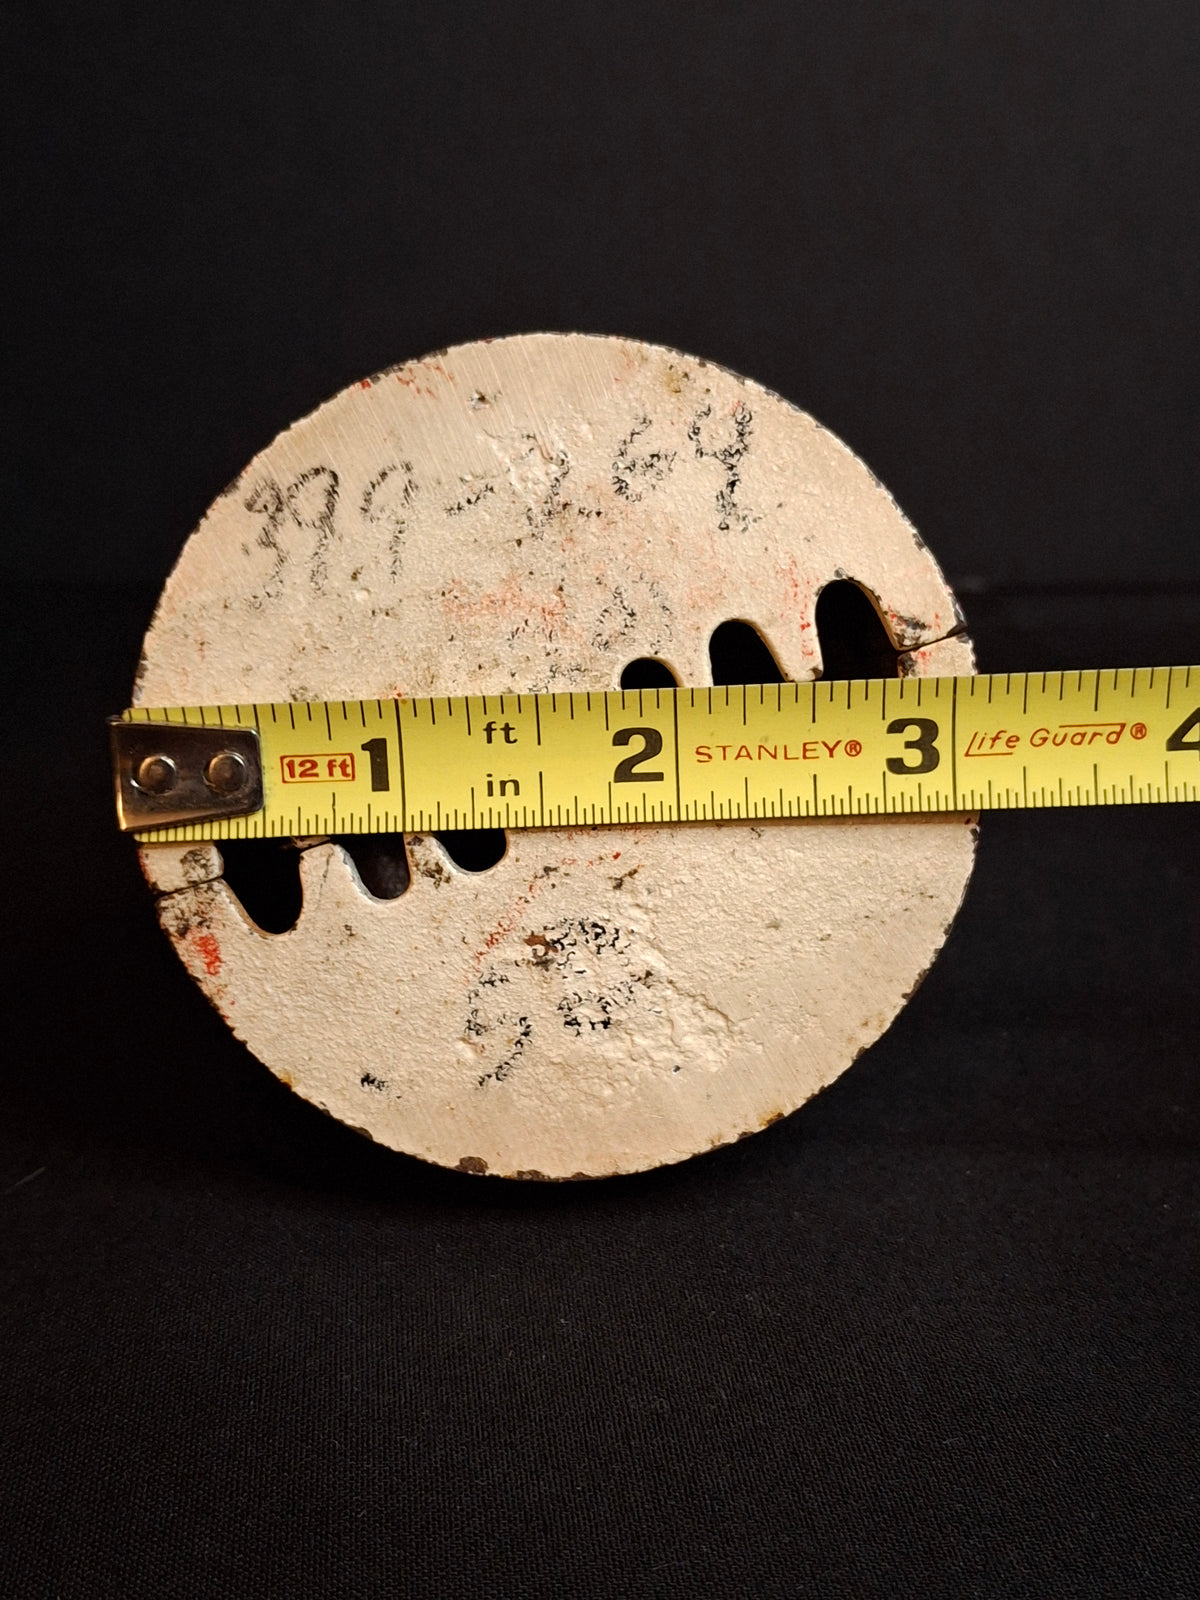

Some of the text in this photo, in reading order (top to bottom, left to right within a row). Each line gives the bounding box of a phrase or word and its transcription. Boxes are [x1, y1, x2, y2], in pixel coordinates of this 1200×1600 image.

[483, 721, 518, 744] ft
[964, 730, 1021, 757] Life
[611, 727, 664, 783] 2
[885, 718, 940, 775] 3
[286, 758, 352, 778] 12 ft
[361, 738, 390, 792] 1
[486, 773, 520, 797] in
